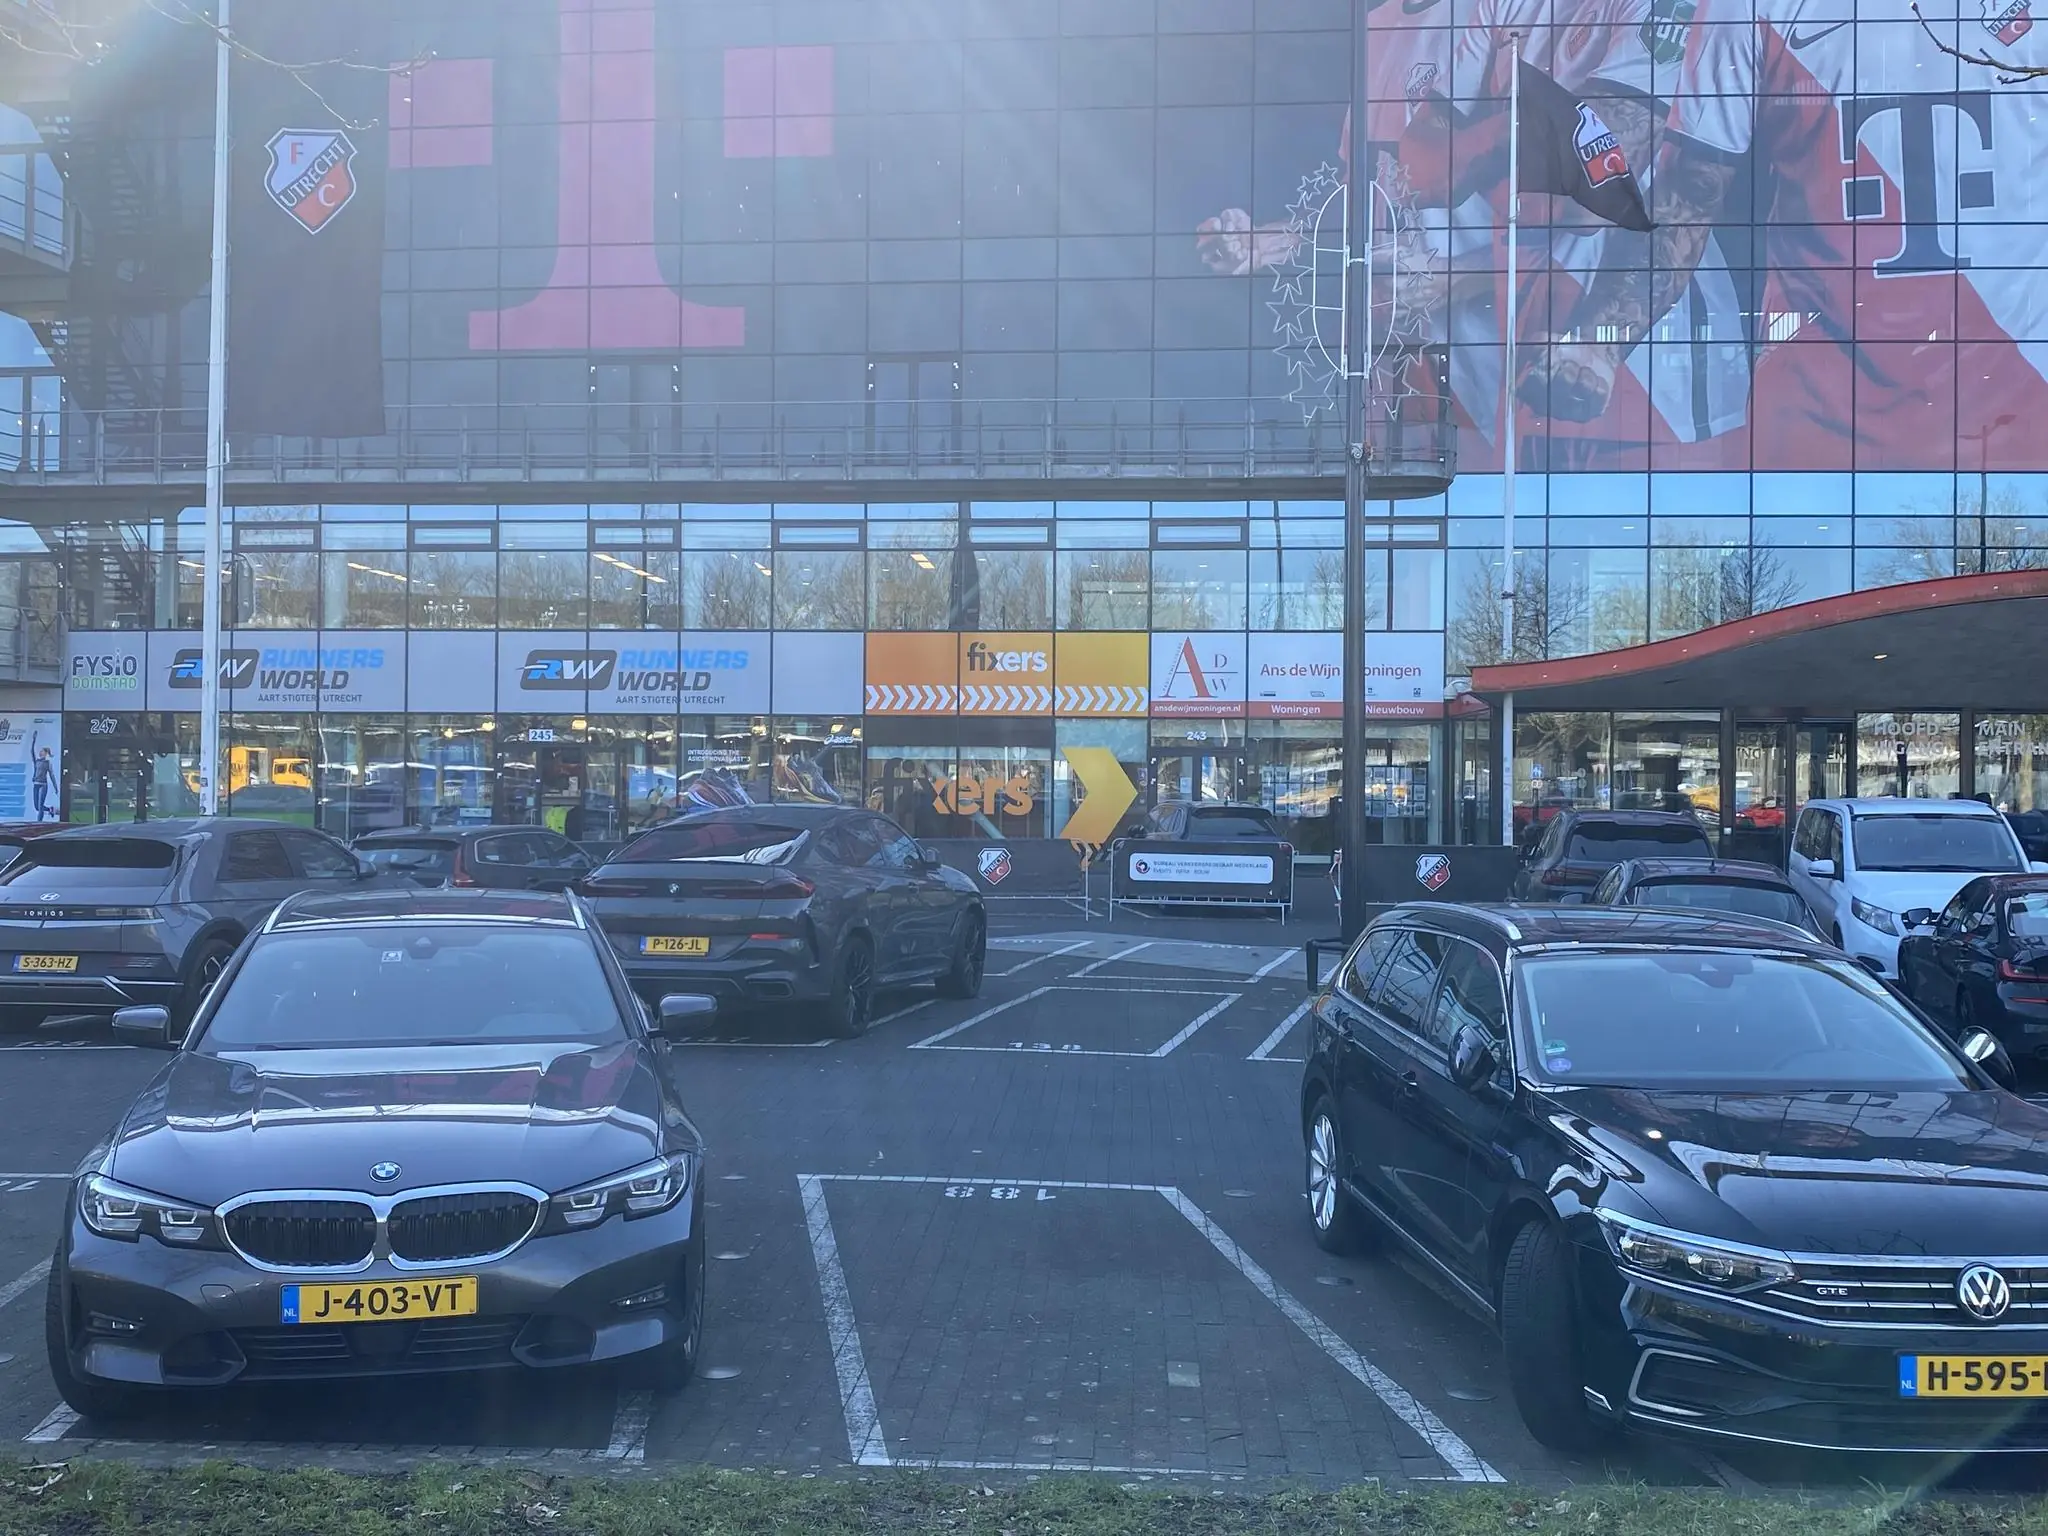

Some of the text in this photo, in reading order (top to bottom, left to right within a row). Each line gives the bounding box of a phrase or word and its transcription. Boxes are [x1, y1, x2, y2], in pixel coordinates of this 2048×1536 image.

[291, 142, 304, 165] F
[280, 140, 345, 207] UTRECHT
[318, 183, 335, 207] C
[261, 649, 384, 668] RUNNERS
[619, 650, 749, 669] RUNNERS
[967, 641, 1048, 672] fixers
[1214, 654, 1227, 668] D
[72, 655, 137, 676] FYSIO
[1158, 636, 1218, 698] A
[1260, 663, 1422, 679] Ans de Wijn oningen
[259, 671, 349, 690] WORLD
[617, 672, 711, 691] WORLD
[323, 694, 362, 702] UTRECHT
[616, 696, 639, 704] AART
[684, 696, 726, 704] UTRECHT
[1154, 704, 1241, 714] ansdewijnwoningen.nl
[1271, 704, 1321, 716] Woningen
[1365, 705, 1425, 715] Nieuwbouw
[90, 718, 118, 734] 247
[1978, 721, 2026, 736] MAIN
[531, 731, 551, 741] 245
[1186, 731, 1207, 741] 243
[652, 938, 702, 951] P-126-JL
[22, 956, 73, 968] S-363-HZ
[1816, 1287, 1849, 1296] GTE
[284, 1283, 463, 1318] NL J-403-VT
[1901, 1361, 2048, 1391] NL H-595-
